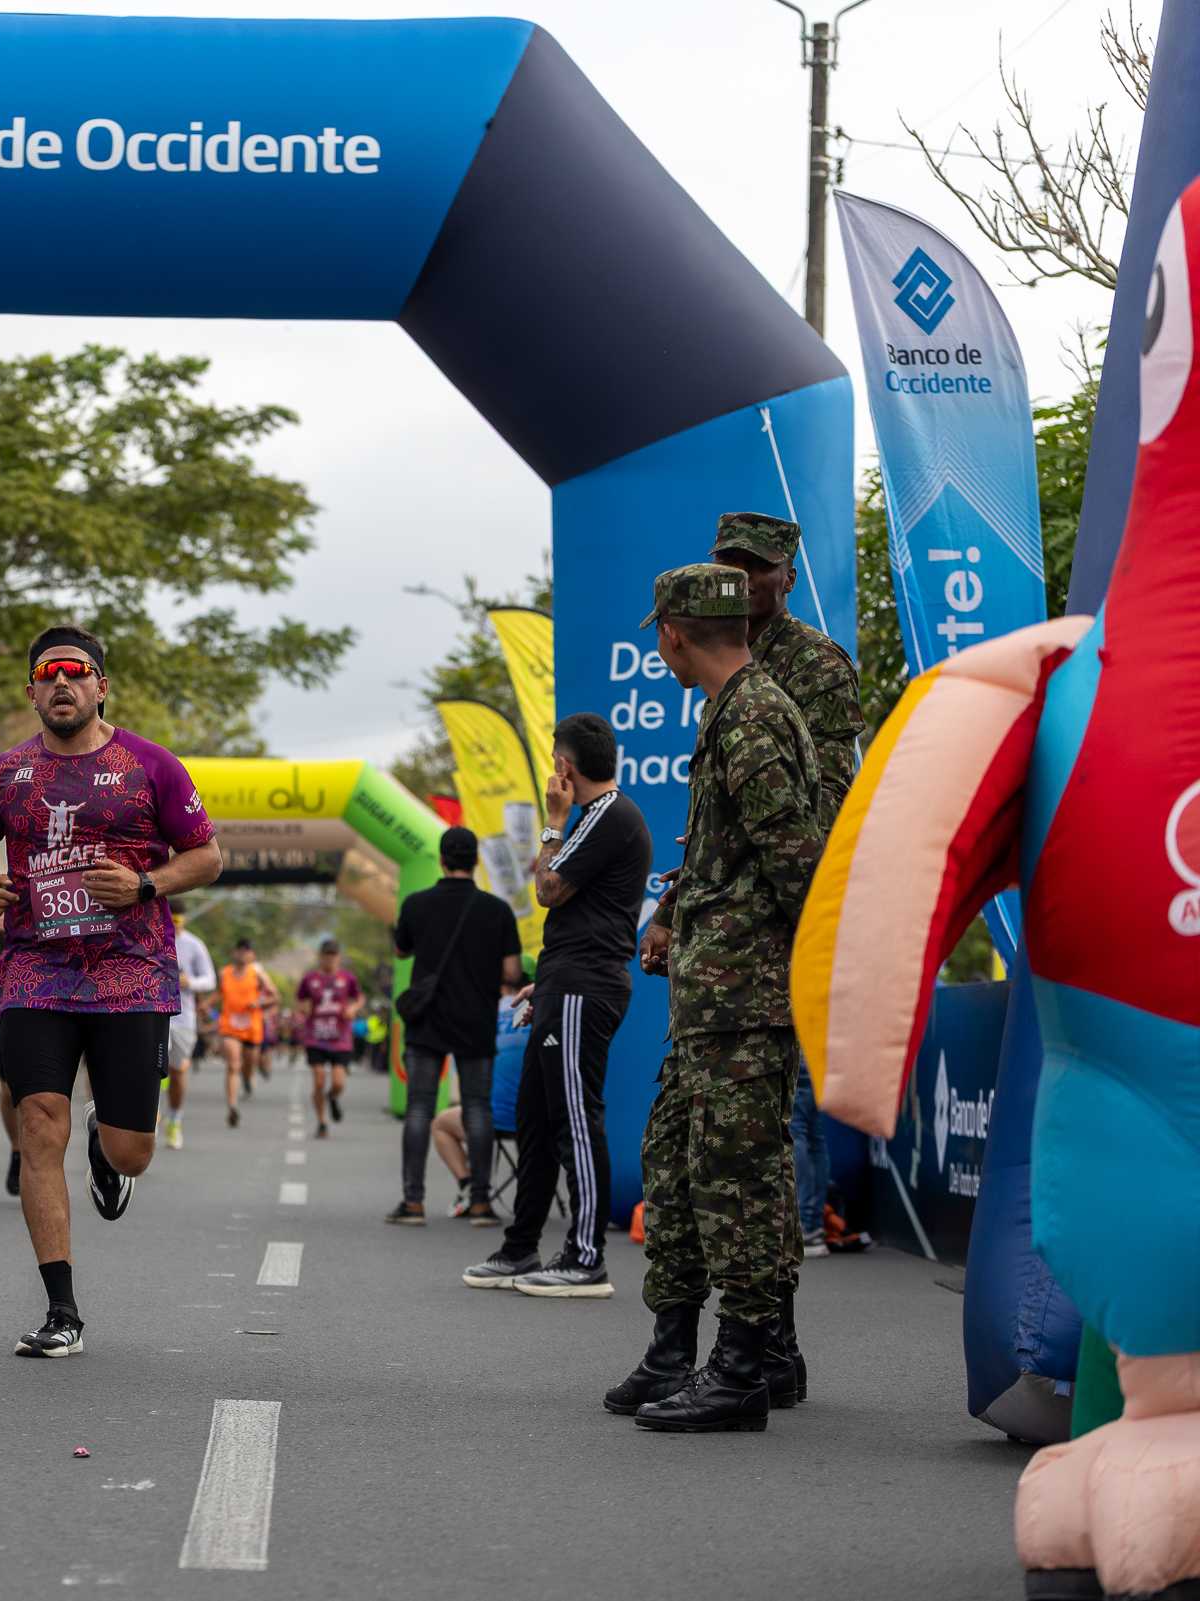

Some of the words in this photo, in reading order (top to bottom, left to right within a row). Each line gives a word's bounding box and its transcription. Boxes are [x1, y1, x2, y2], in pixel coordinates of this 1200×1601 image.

[76, 118, 381, 174] Occidente
[886, 343, 950, 365] Banco
[955, 343, 982, 365] de
[885, 370, 992, 394] Occidente
[609, 641, 676, 681] De
[610, 689, 665, 731] de
[93, 772, 125, 786] 10K
[28, 841, 107, 873] MMCAFÉ
[90, 923, 112, 932] 2.11.25
